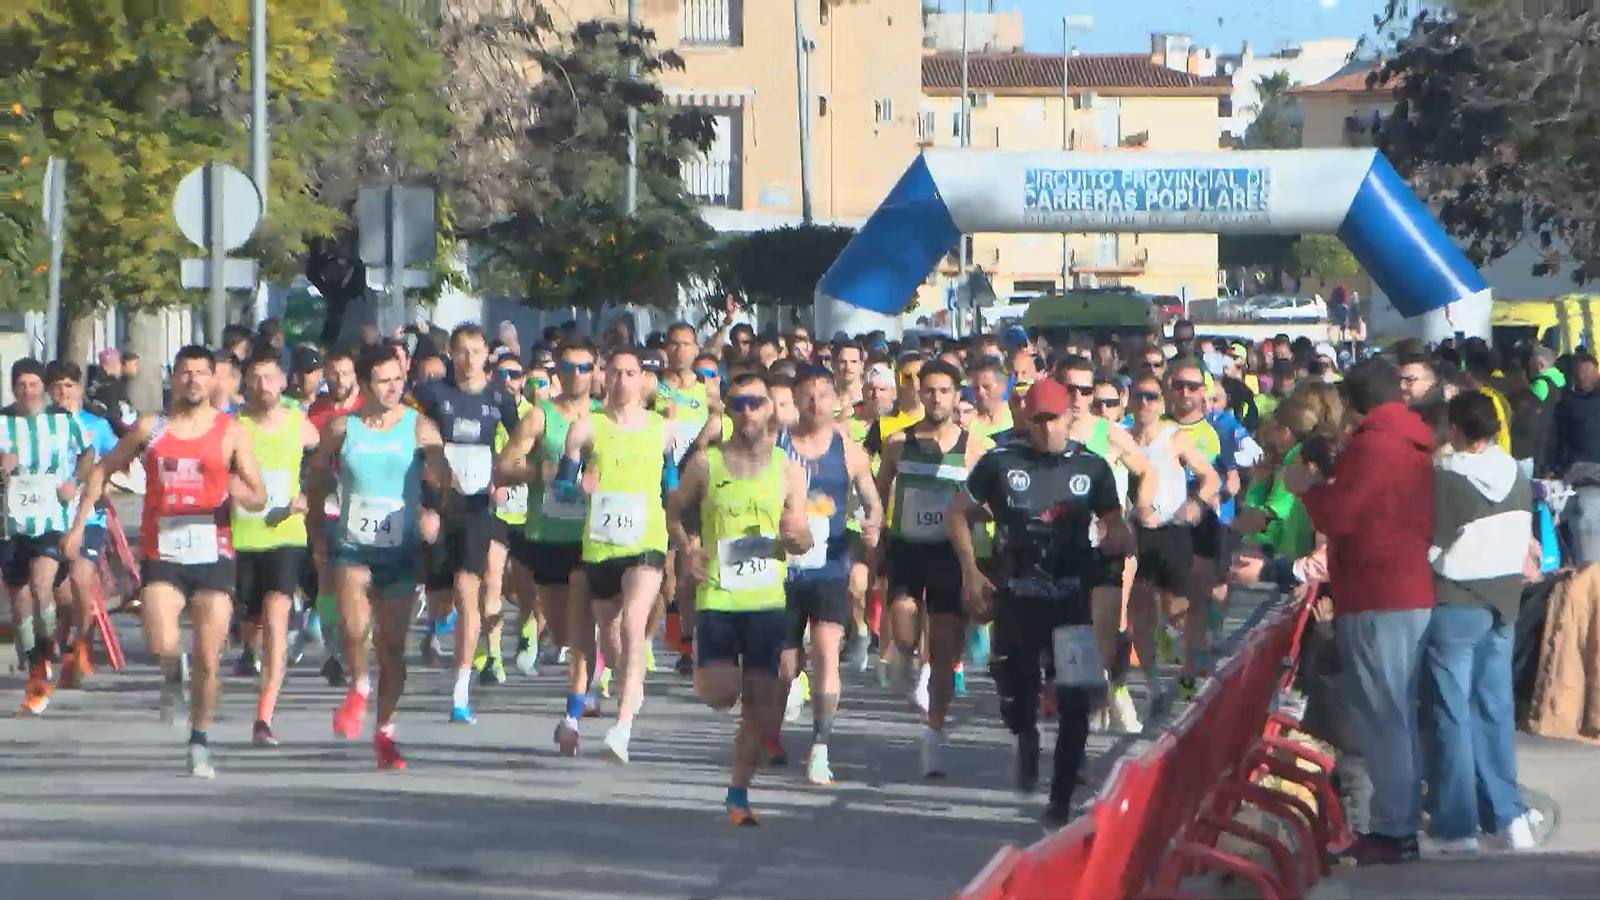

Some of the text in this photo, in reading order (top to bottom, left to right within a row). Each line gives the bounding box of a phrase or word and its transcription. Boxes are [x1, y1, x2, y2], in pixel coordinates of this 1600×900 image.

[1023, 187, 1270, 211] CARRERAS POPULARES
[360, 518, 392, 534] 214
